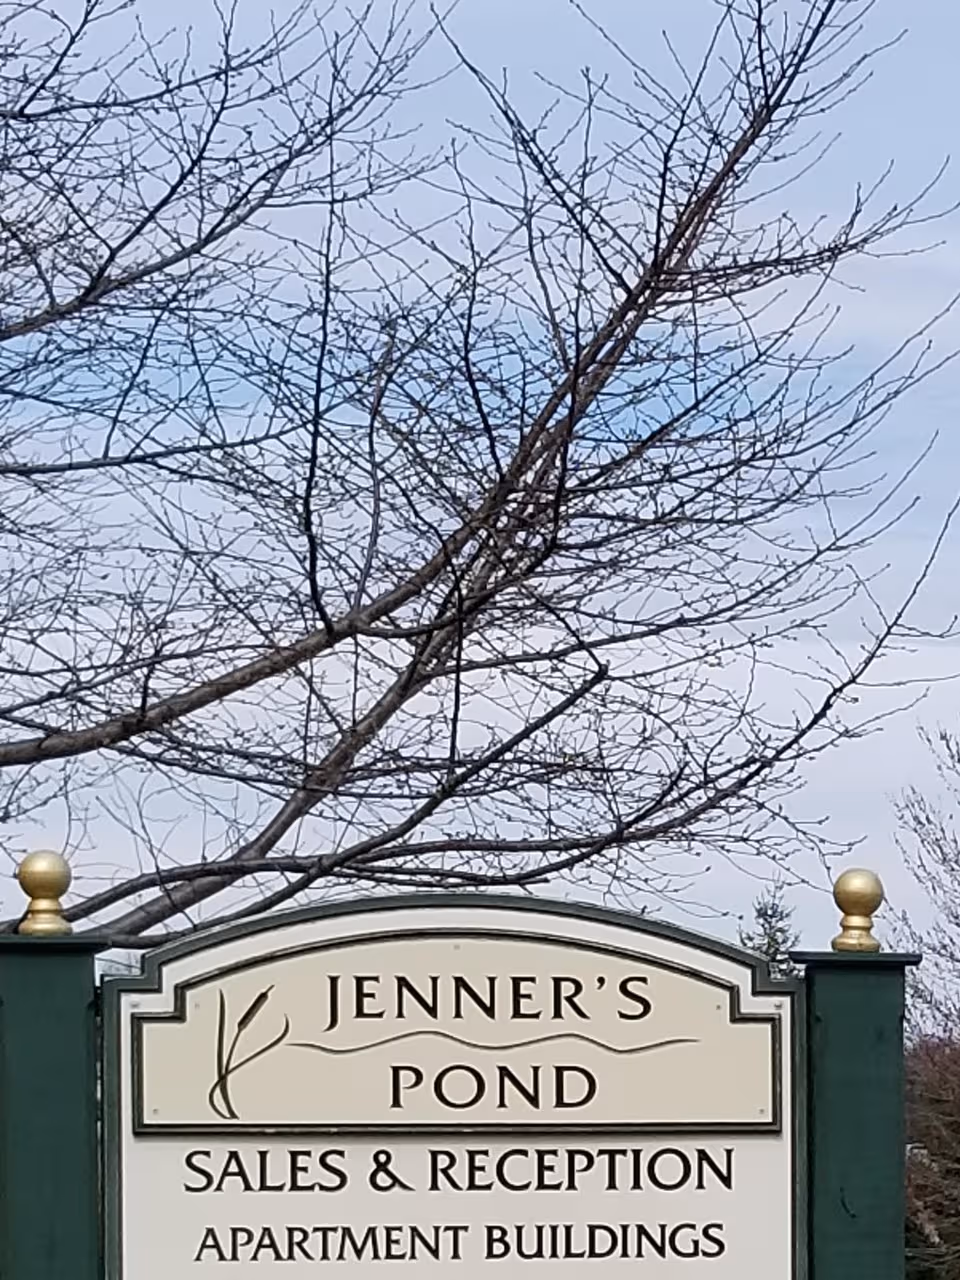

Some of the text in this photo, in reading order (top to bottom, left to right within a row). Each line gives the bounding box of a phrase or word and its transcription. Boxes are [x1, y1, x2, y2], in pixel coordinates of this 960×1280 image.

[323, 975, 651, 1031] JENNER'S
[390, 1065, 597, 1109] POND
[183, 1147, 734, 1192] SALES & RECEPTION
[194, 1223, 725, 1262] APARTMENT BUILDINGS
